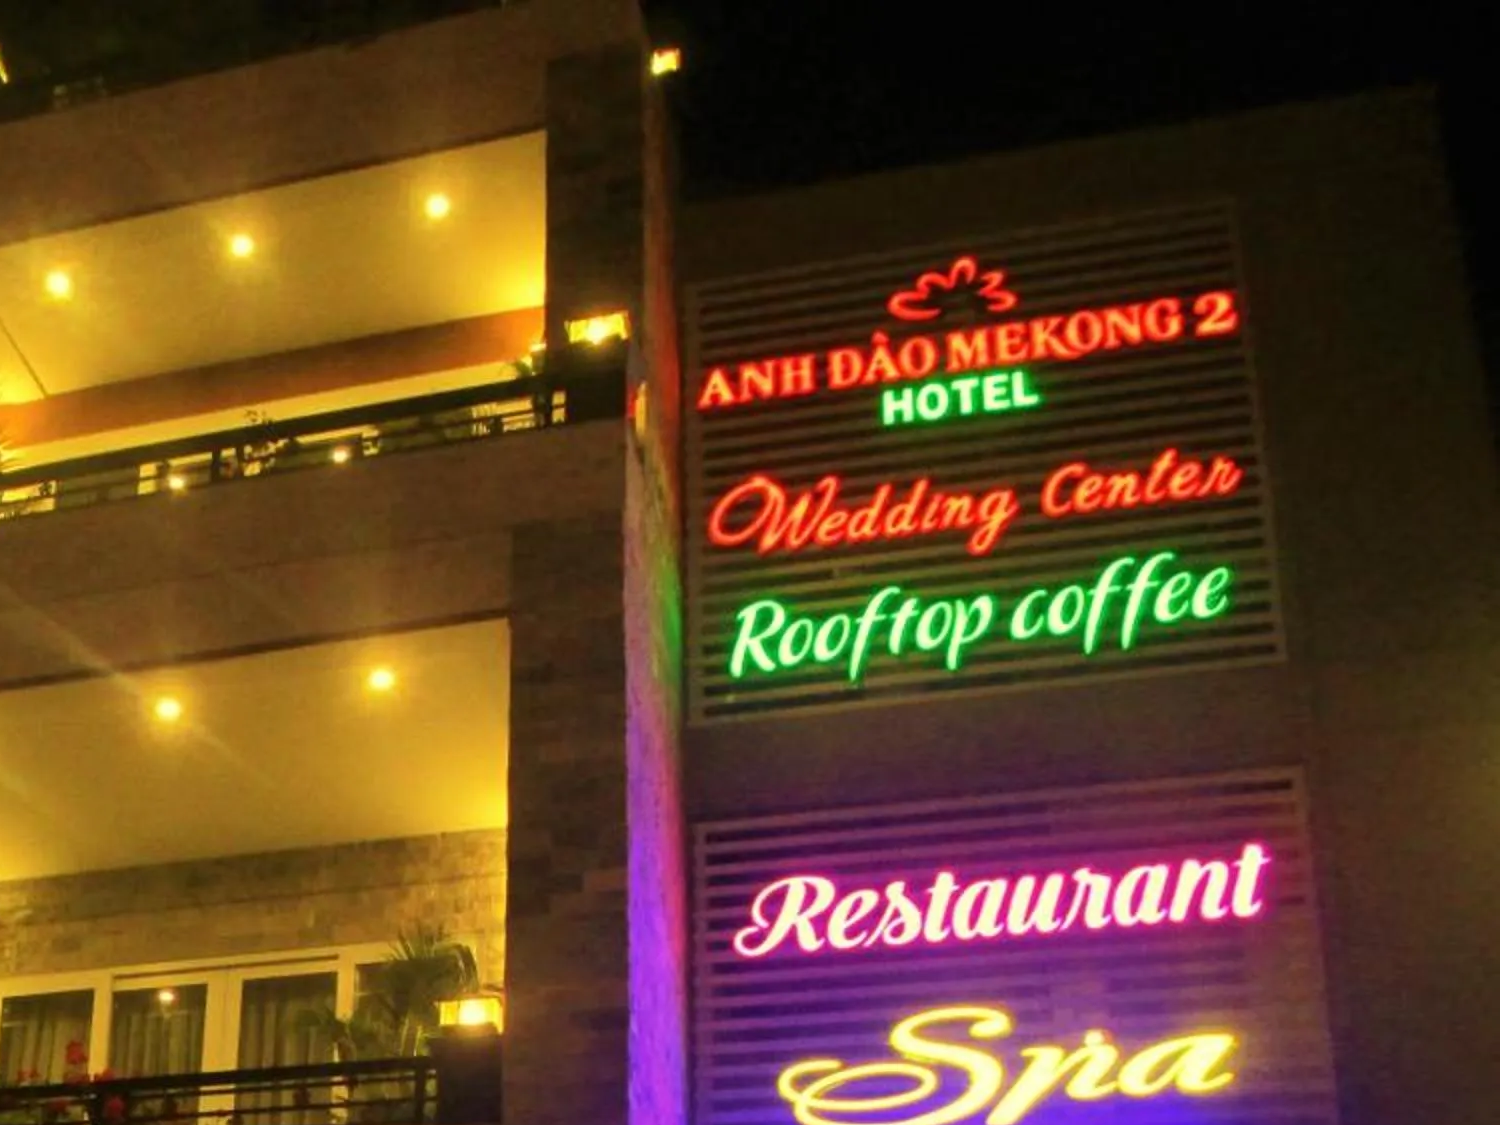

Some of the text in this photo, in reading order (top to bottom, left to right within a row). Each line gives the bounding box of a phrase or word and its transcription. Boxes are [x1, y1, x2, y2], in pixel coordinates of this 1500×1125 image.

[698, 356, 816, 409] ANH
[945, 299, 1182, 370] MEKONG
[1193, 292, 1238, 335] 2
[882, 371, 1040, 425] HOTEL
[708, 450, 1242, 555] Wedding Center
[729, 553, 1230, 680] Rooftop coffee
[733, 844, 1269, 957] Restaurant
